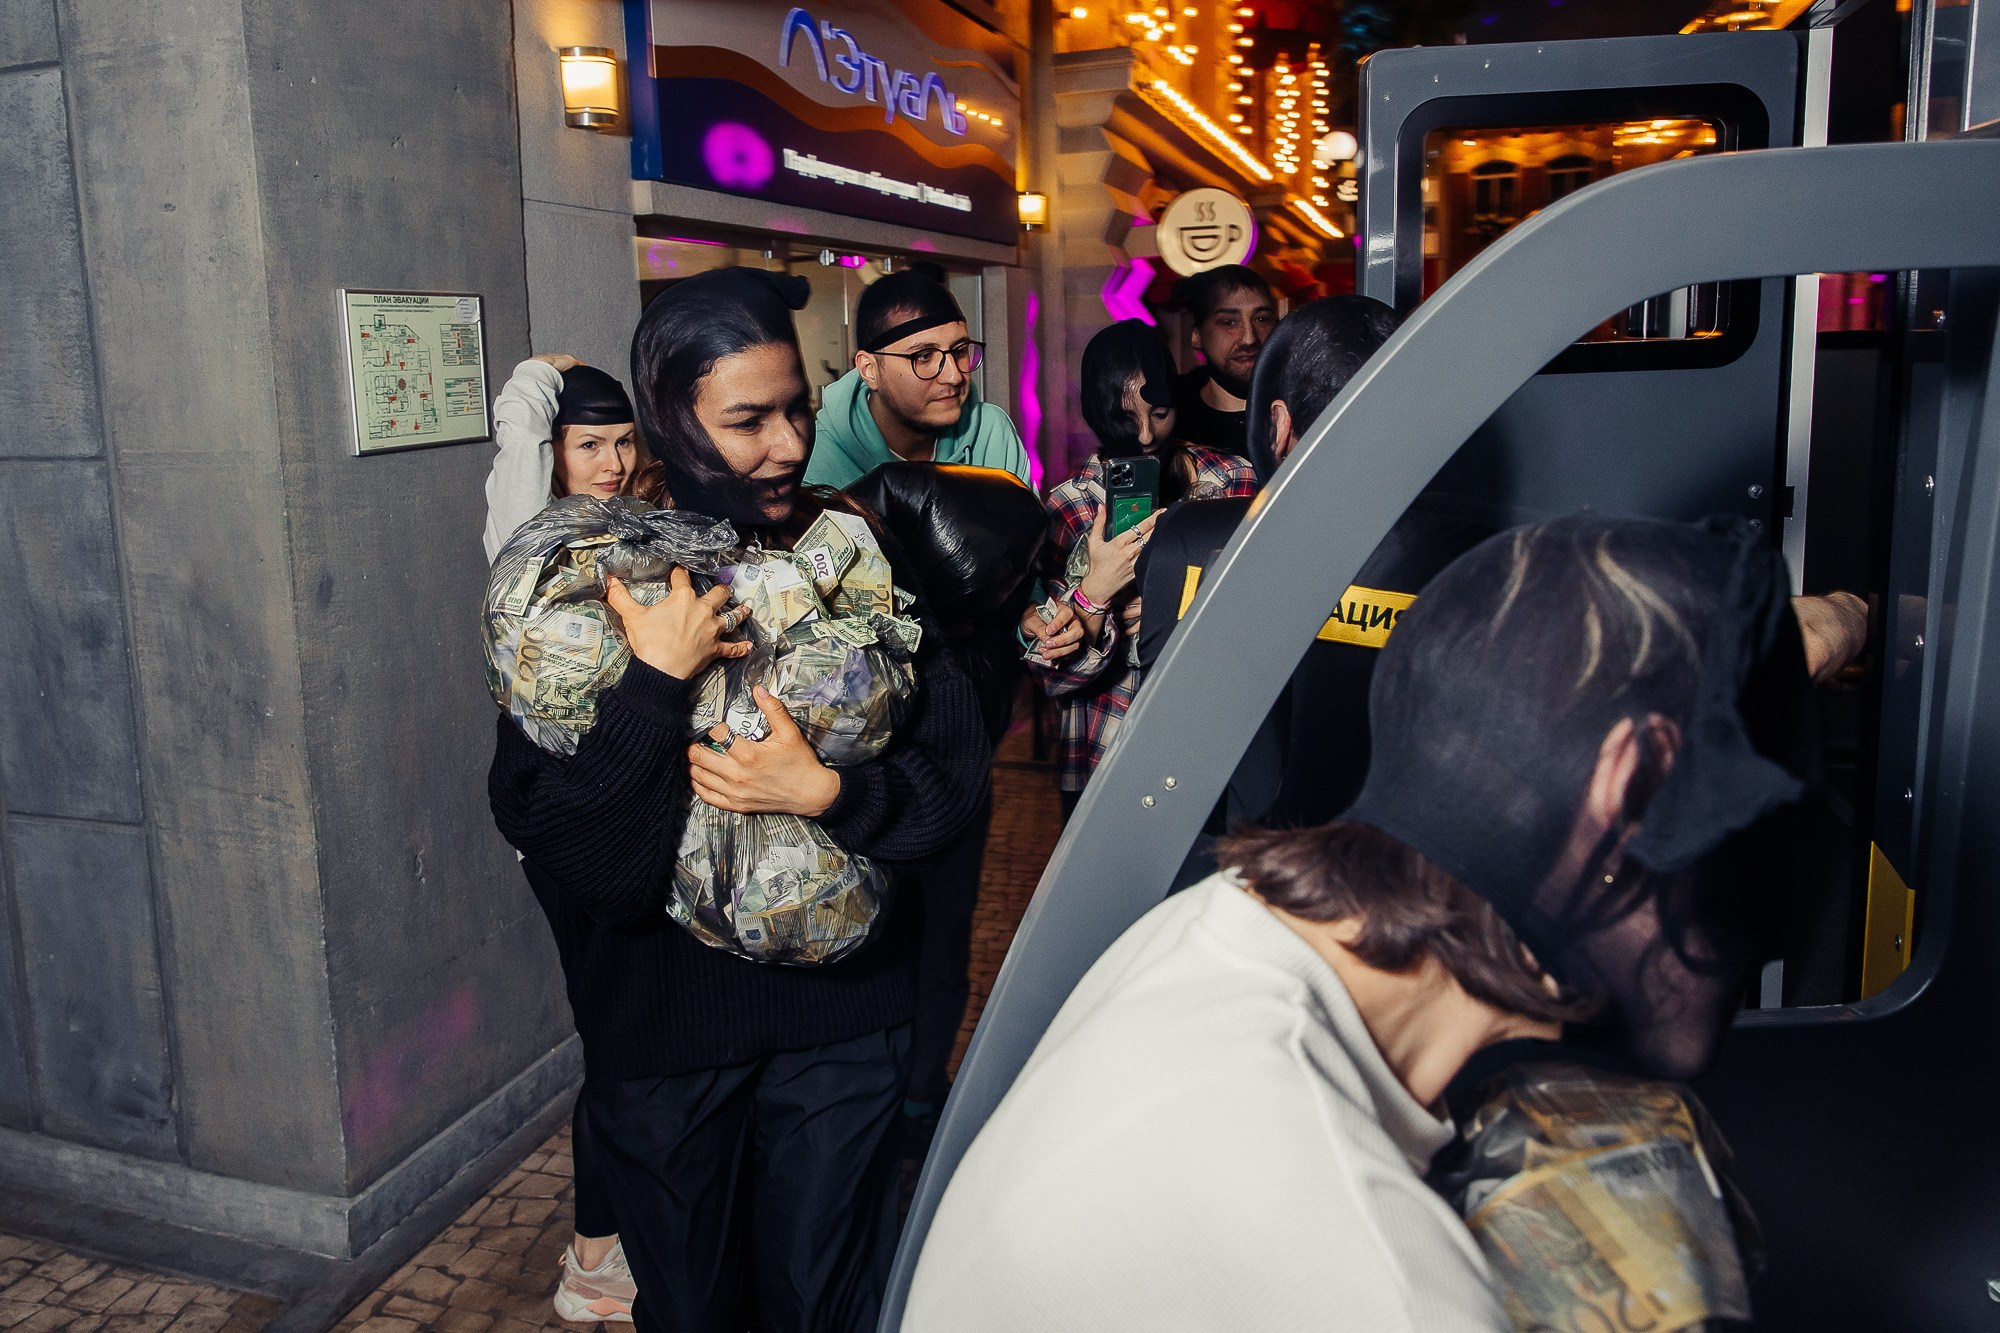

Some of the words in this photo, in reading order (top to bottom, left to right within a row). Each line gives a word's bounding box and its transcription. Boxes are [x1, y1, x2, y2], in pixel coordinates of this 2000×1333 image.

[373, 296, 391, 304] ПЛАН
[392, 296, 429, 304] ЭВАКУАЦИИ
[814, 553, 829, 578] 200
[519, 627, 547, 682] 200
